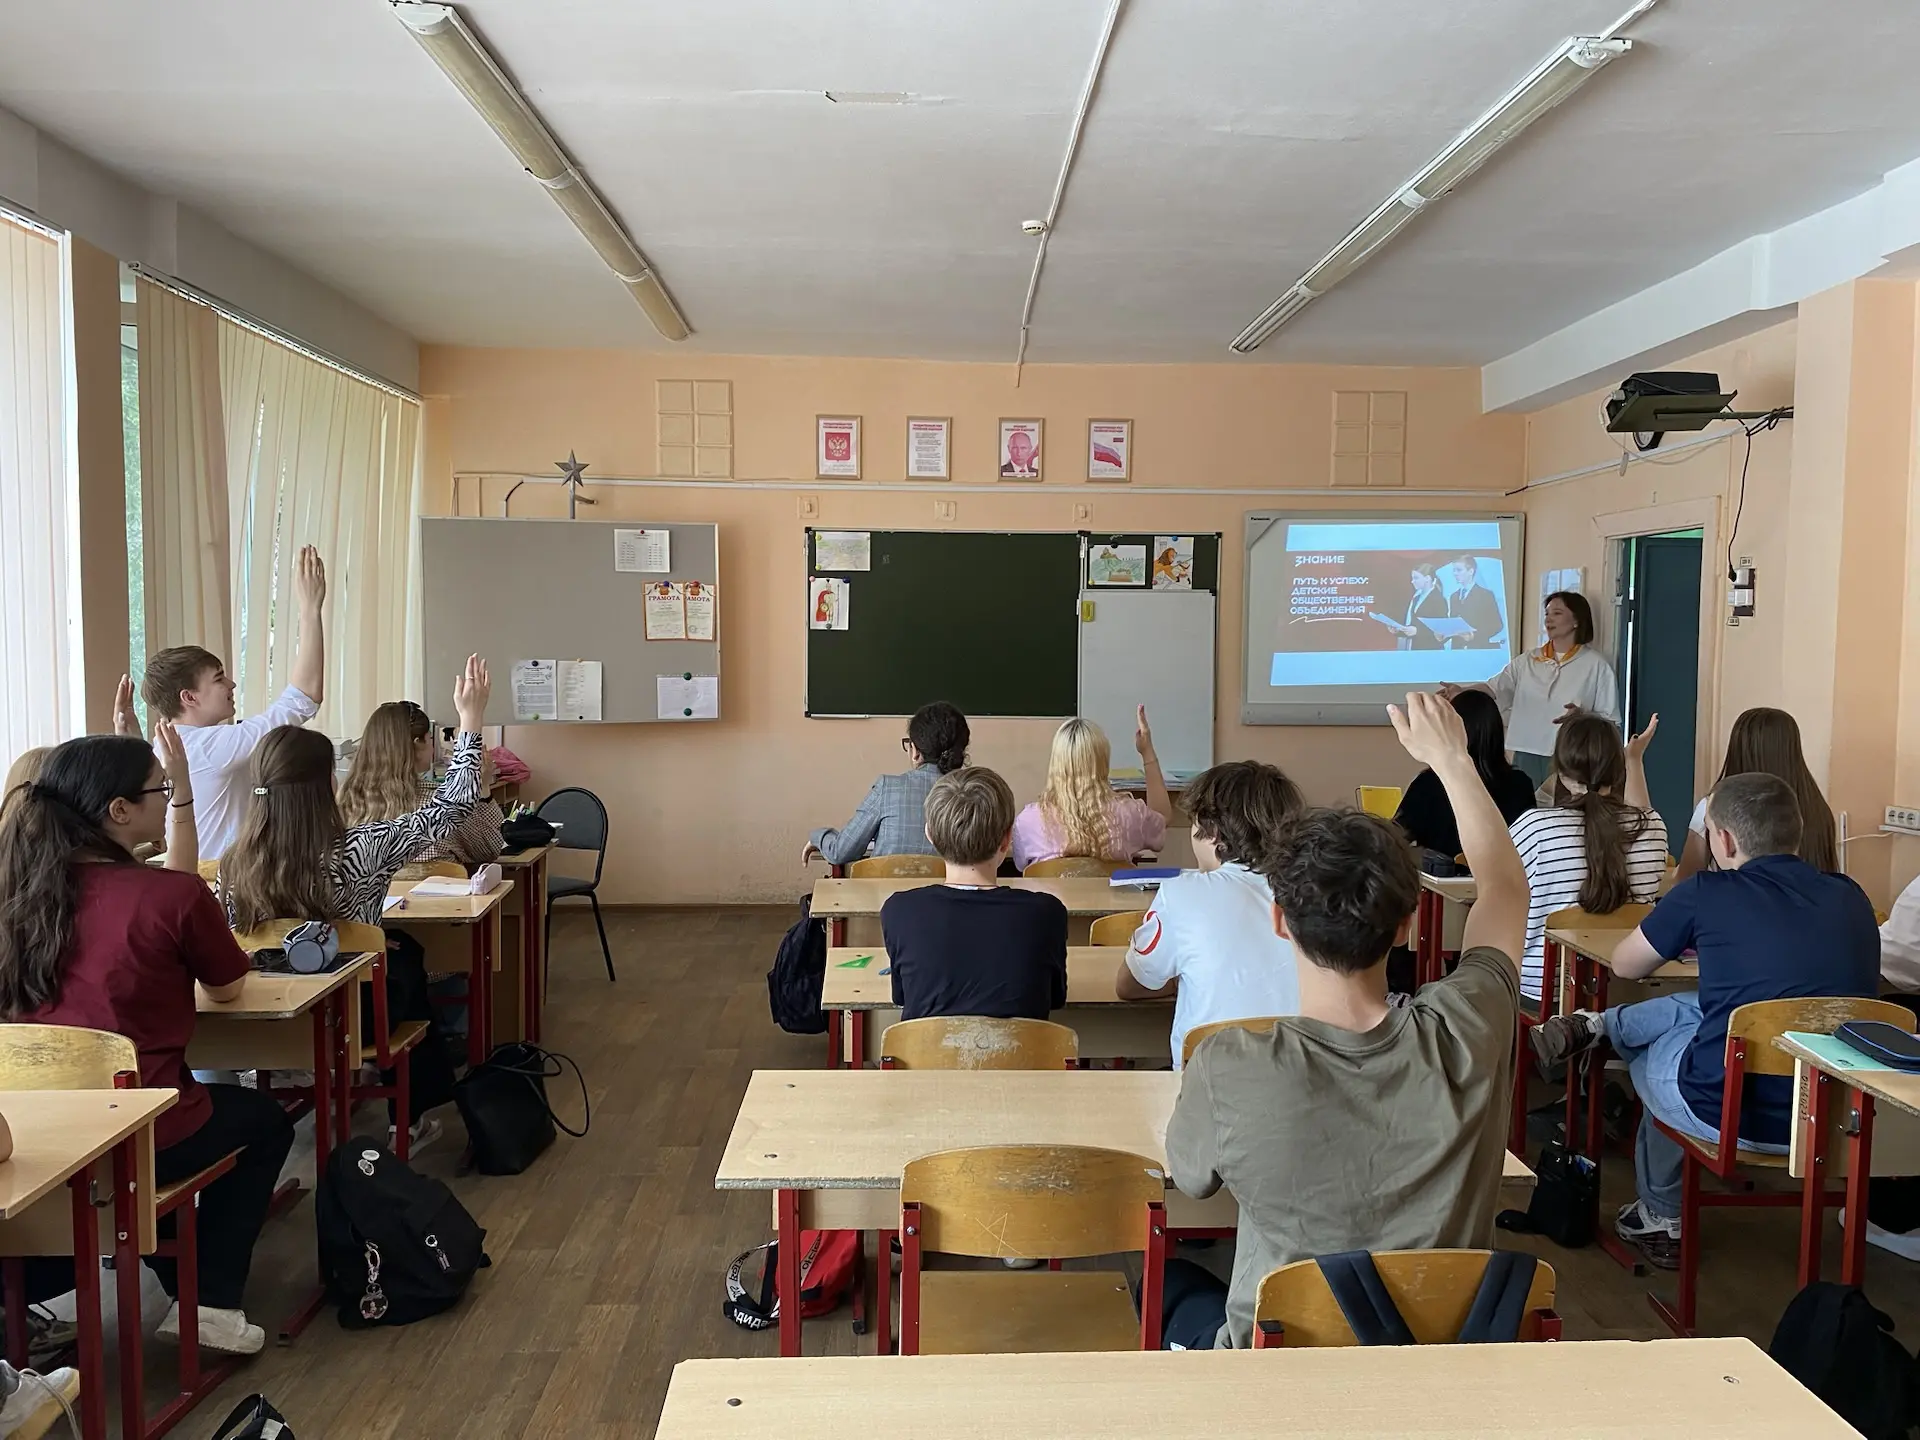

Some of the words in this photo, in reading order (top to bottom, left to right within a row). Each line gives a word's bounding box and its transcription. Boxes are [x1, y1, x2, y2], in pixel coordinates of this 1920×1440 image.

[1293, 577, 1319, 585] ПУТЬ
[1320, 577, 1328, 585] К
[1330, 576, 1369, 585] УСПЕХУ:
[1291, 586, 1338, 595] ДЕТСКИЕ
[1290, 595, 1375, 605] ОБЩЕСТВЕННЫЕ
[1290, 605, 1366, 615] ОБЪЕДИНЕНИЯ
